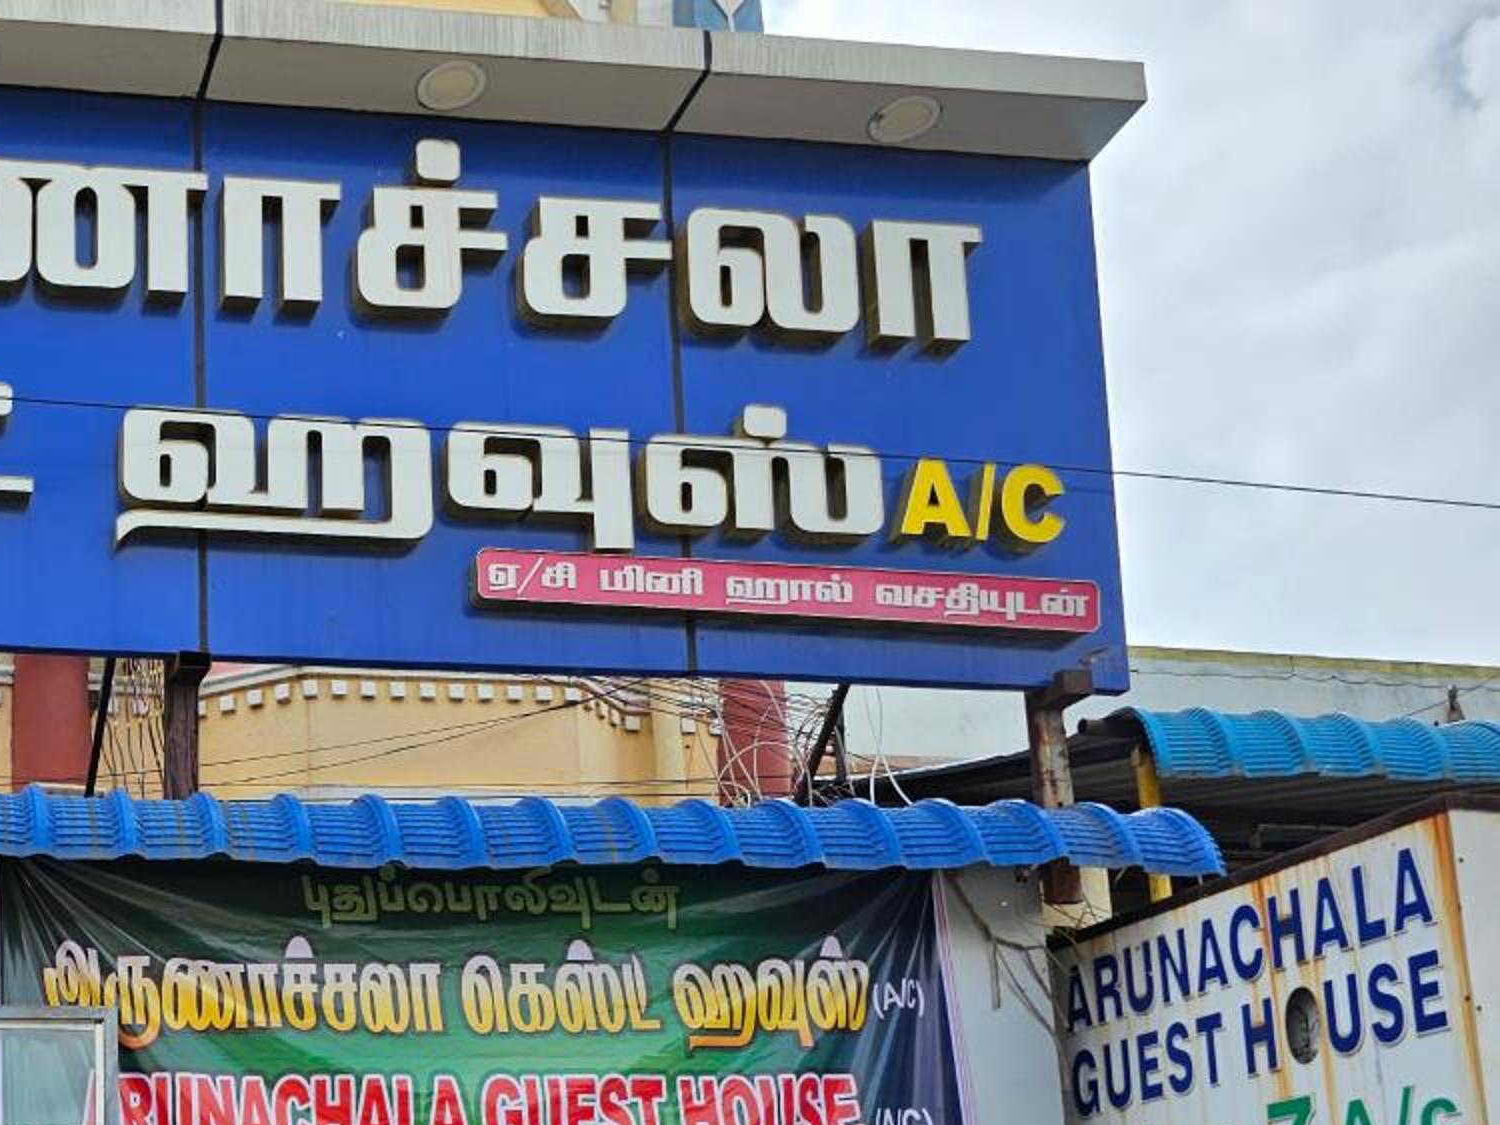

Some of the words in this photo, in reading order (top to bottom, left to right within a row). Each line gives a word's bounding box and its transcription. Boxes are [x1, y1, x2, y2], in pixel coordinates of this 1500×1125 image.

[114, 402, 885, 549] ஹவுஸ்
[900, 457, 1067, 544] A/C
[599, 563, 704, 596] மினி
[725, 573, 853, 605] ஹால்
[874, 581, 1090, 622] வசதியுடன்
[673, 935, 869, 1048] ஹவுஸ்
[1066, 847, 1437, 1035] ARUNACHALA
[1071, 1011, 1223, 1118] GUEST
[1243, 948, 1449, 1077] HOUSE
